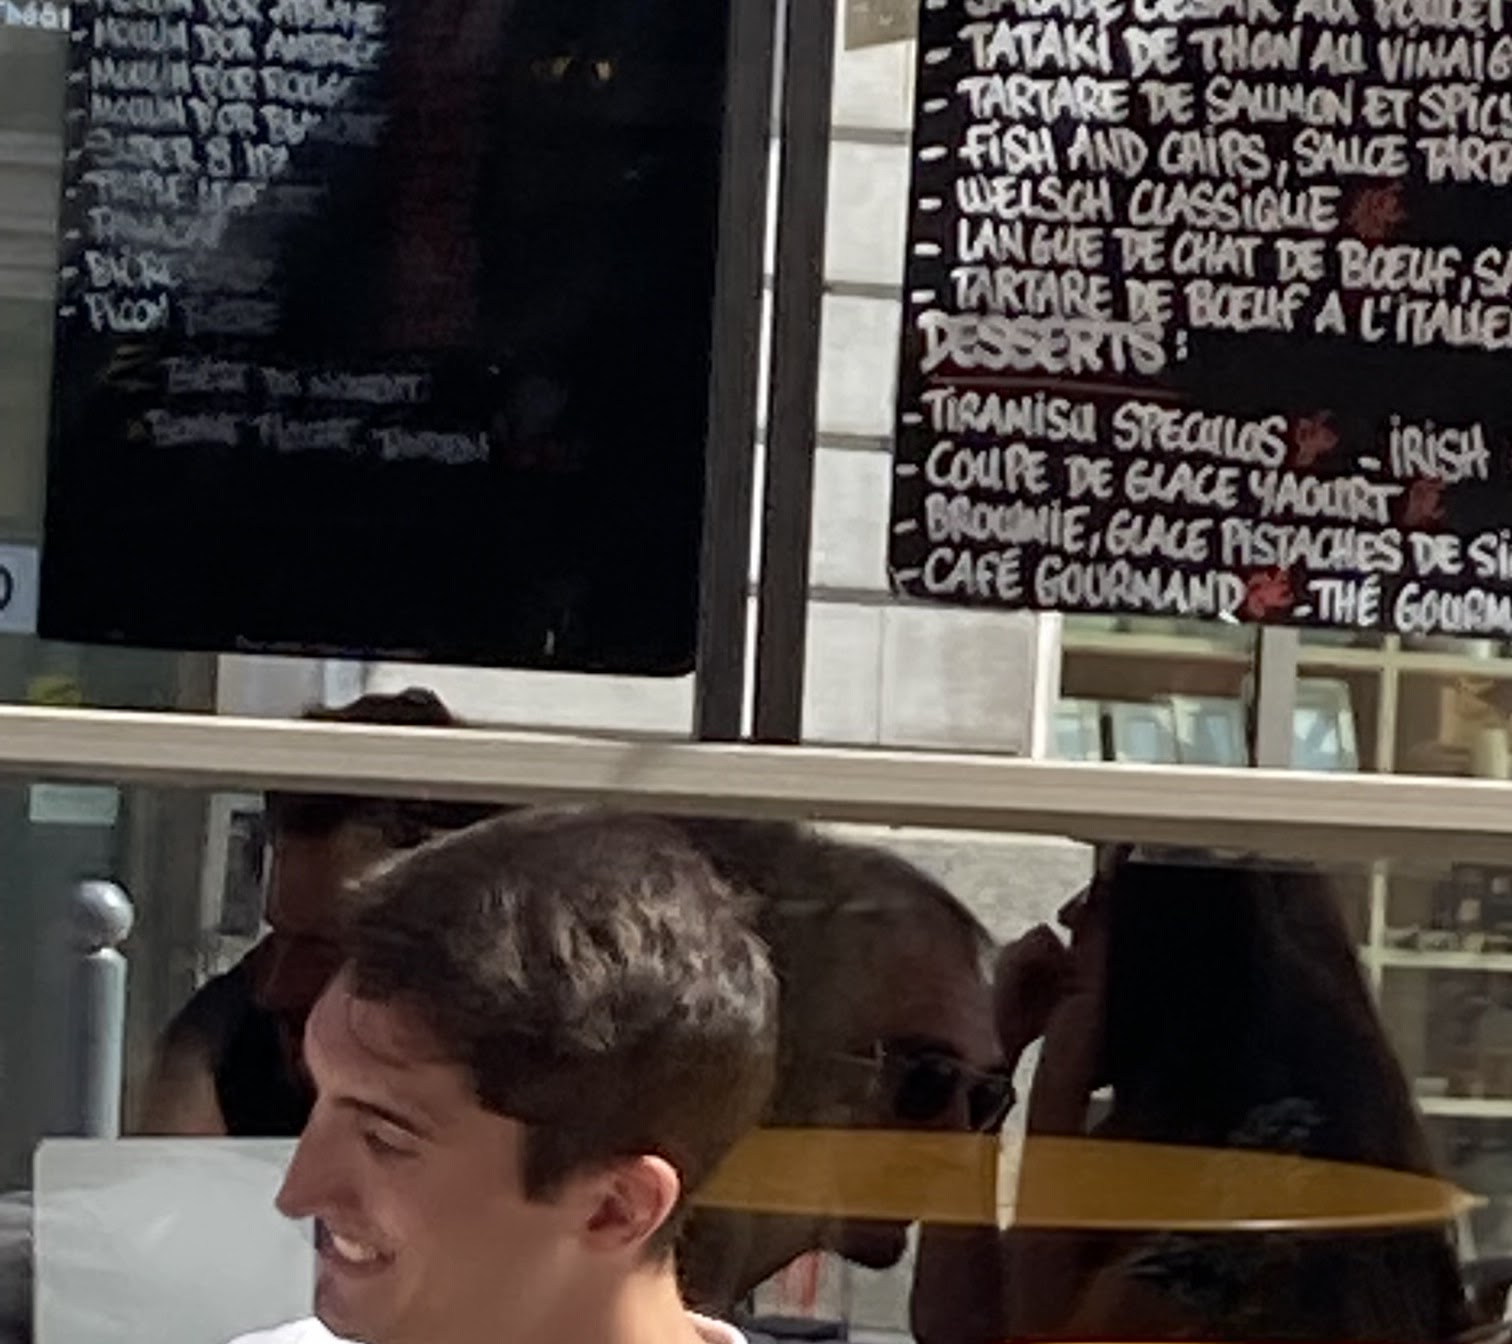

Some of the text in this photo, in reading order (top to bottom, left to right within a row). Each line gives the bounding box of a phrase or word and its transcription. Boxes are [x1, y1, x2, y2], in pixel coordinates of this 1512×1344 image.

[957, 19, 1112, 73] TATAKI
[1122, 26, 1182, 77] DE
[1187, 24, 1299, 73] THON
[1310, 29, 1367, 74] AU
[956, 74, 1130, 123] TARTARE
[1139, 81, 1194, 125] DE
[1205, 76, 1353, 127] SAUMON
[1361, 87, 1415, 127] ET
[959, 119, 1059, 174] FISH
[1069, 126, 1149, 178] AND
[1294, 128, 1408, 177] SAUCE
[956, 174, 1115, 223] WELSCH
[1128, 178, 1342, 231] CLASSIQUE
[957, 218, 1103, 266] LANGUE
[1113, 228, 1168, 270] DE
[1172, 236, 1263, 277] CHAT
[1274, 239, 1326, 281] DE
[951, 264, 1112, 317] TARTARE
[1125, 280, 1173, 324] DE
[921, 386, 1096, 443] TIRAMISU
[1113, 402, 1287, 467] SPECULOS
[1390, 414, 1491, 481] IRISH
[926, 441, 1048, 493] COUPE
[1065, 455, 1113, 500] DE
[1126, 459, 1241, 509] GLACE
[1248, 469, 1403, 524] YAOURT
[1106, 517, 1214, 562] GLACE
[1220, 517, 1402, 573] PISTACHES
[1409, 532, 1464, 575] DE
[923, 546, 1022, 599] CAFÉ
[1035, 558, 1247, 615] GOURMAND
[1309, 576, 1381, 626] THÉ
